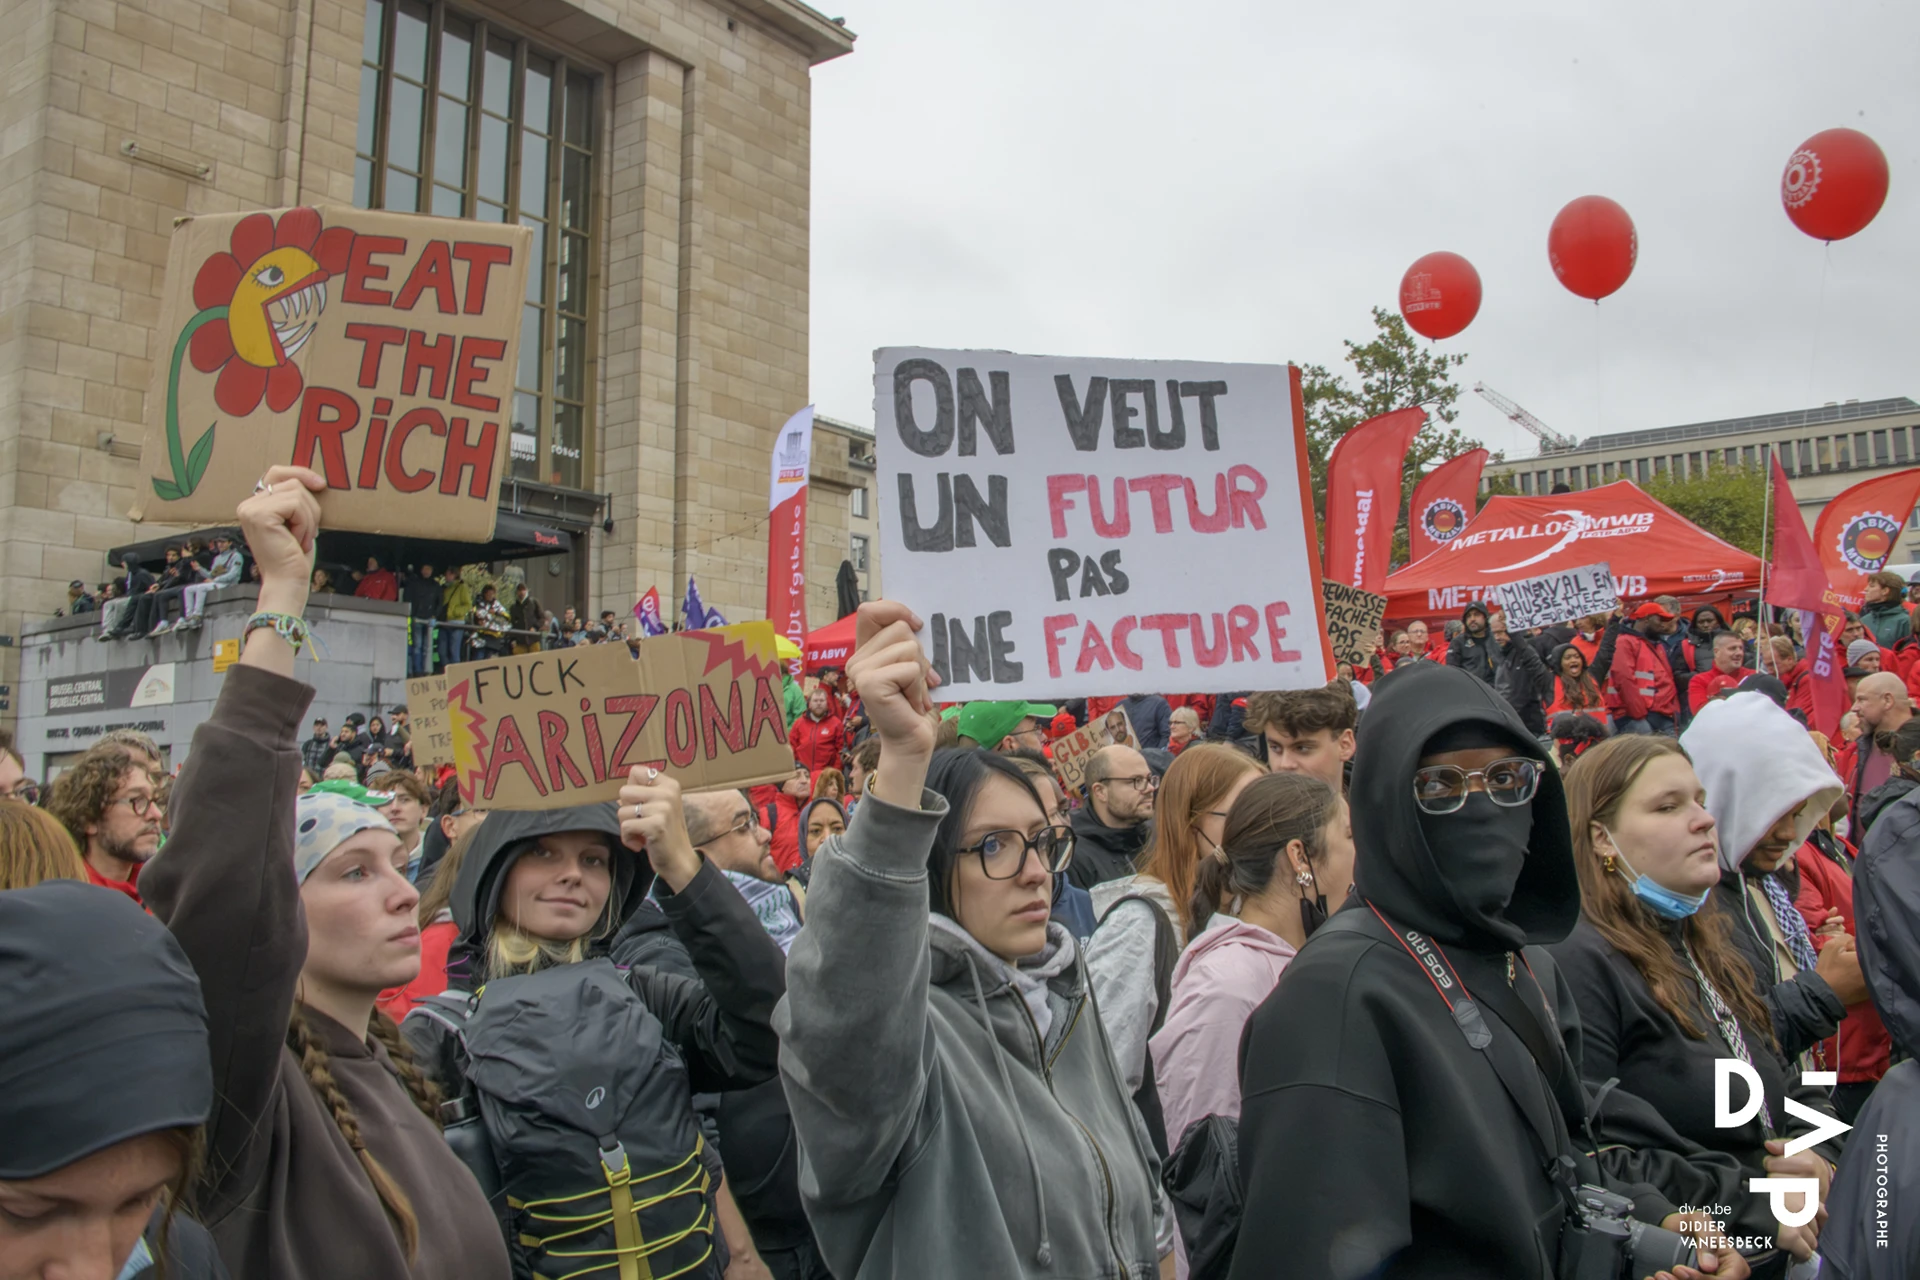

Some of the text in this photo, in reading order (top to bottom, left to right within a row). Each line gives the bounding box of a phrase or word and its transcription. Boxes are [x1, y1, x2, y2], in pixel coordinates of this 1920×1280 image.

[341, 234, 513, 316] EAT
[344, 322, 508, 413] THE
[893, 358, 1229, 457] ON VEUT
[897, 463, 1268, 553] UN FUTUR
[1433, 502, 1459, 513] ABVV
[1353, 489, 1373, 588] vmetaal
[1858, 518, 1896, 533] ABVV
[1846, 547, 1887, 569] META
[1047, 547, 1130, 601] PAS
[1593, 570, 1614, 591] EN
[1428, 585, 1500, 609] META
[1043, 601, 1302, 679] FACTURE
[1328, 621, 1362, 647] PAS
[820, 647, 848, 660] ABVV
[411, 681, 429, 696] ON
[474, 658, 585, 704] FUCK
[430, 698, 449, 711] PO
[414, 716, 438, 729] PAS
[1055, 732, 1090, 764] GLB
[1406, 931, 1453, 988] EOS R10
